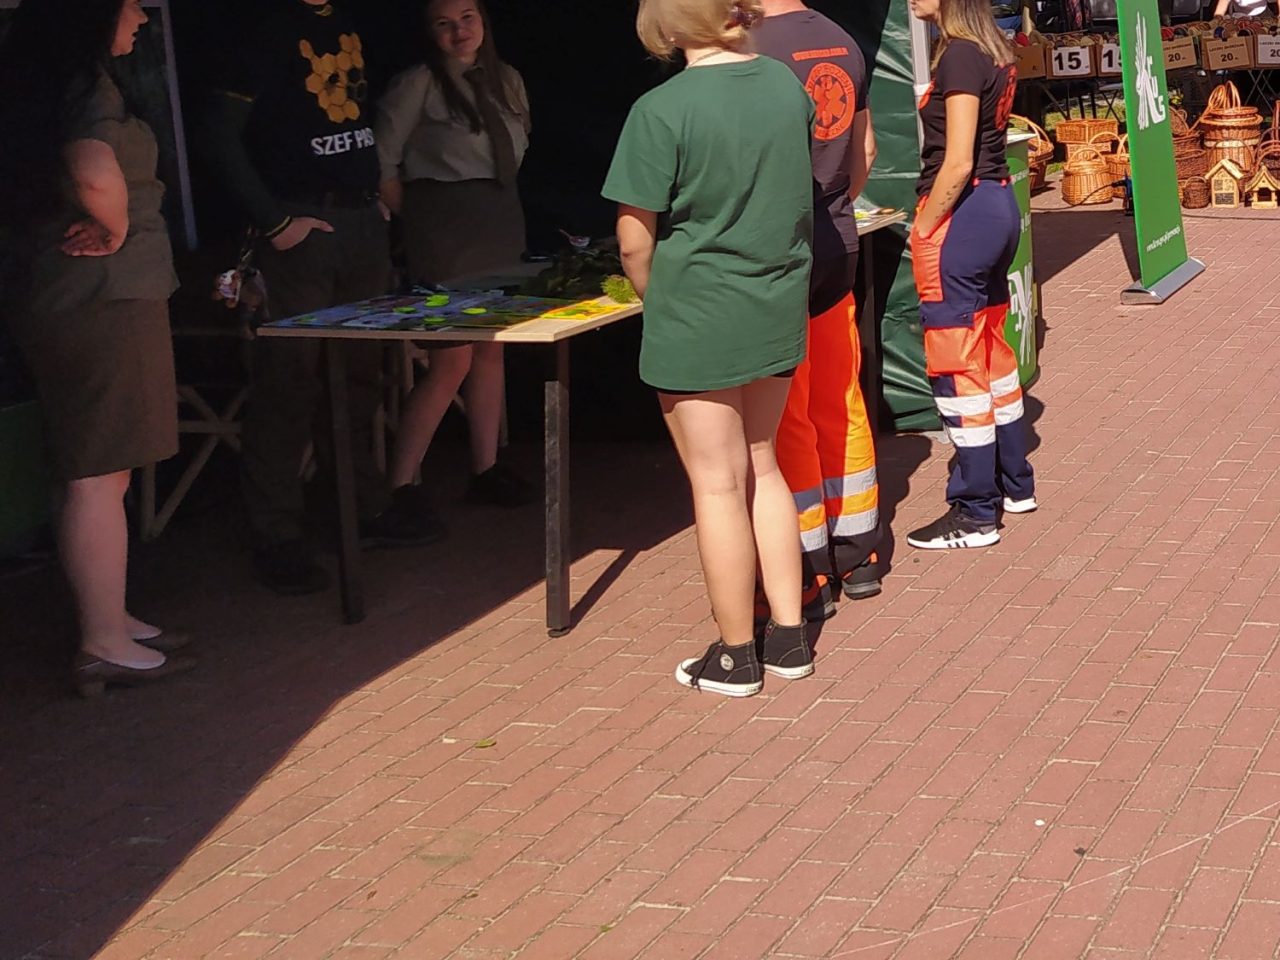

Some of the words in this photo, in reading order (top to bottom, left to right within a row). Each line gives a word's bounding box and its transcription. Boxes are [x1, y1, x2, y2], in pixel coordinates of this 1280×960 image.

[1054, 52, 1082, 70] 15
[1168, 52, 1181, 62] 20
[1220, 52, 1234, 62] 20
[310, 131, 353, 155] SZEF
